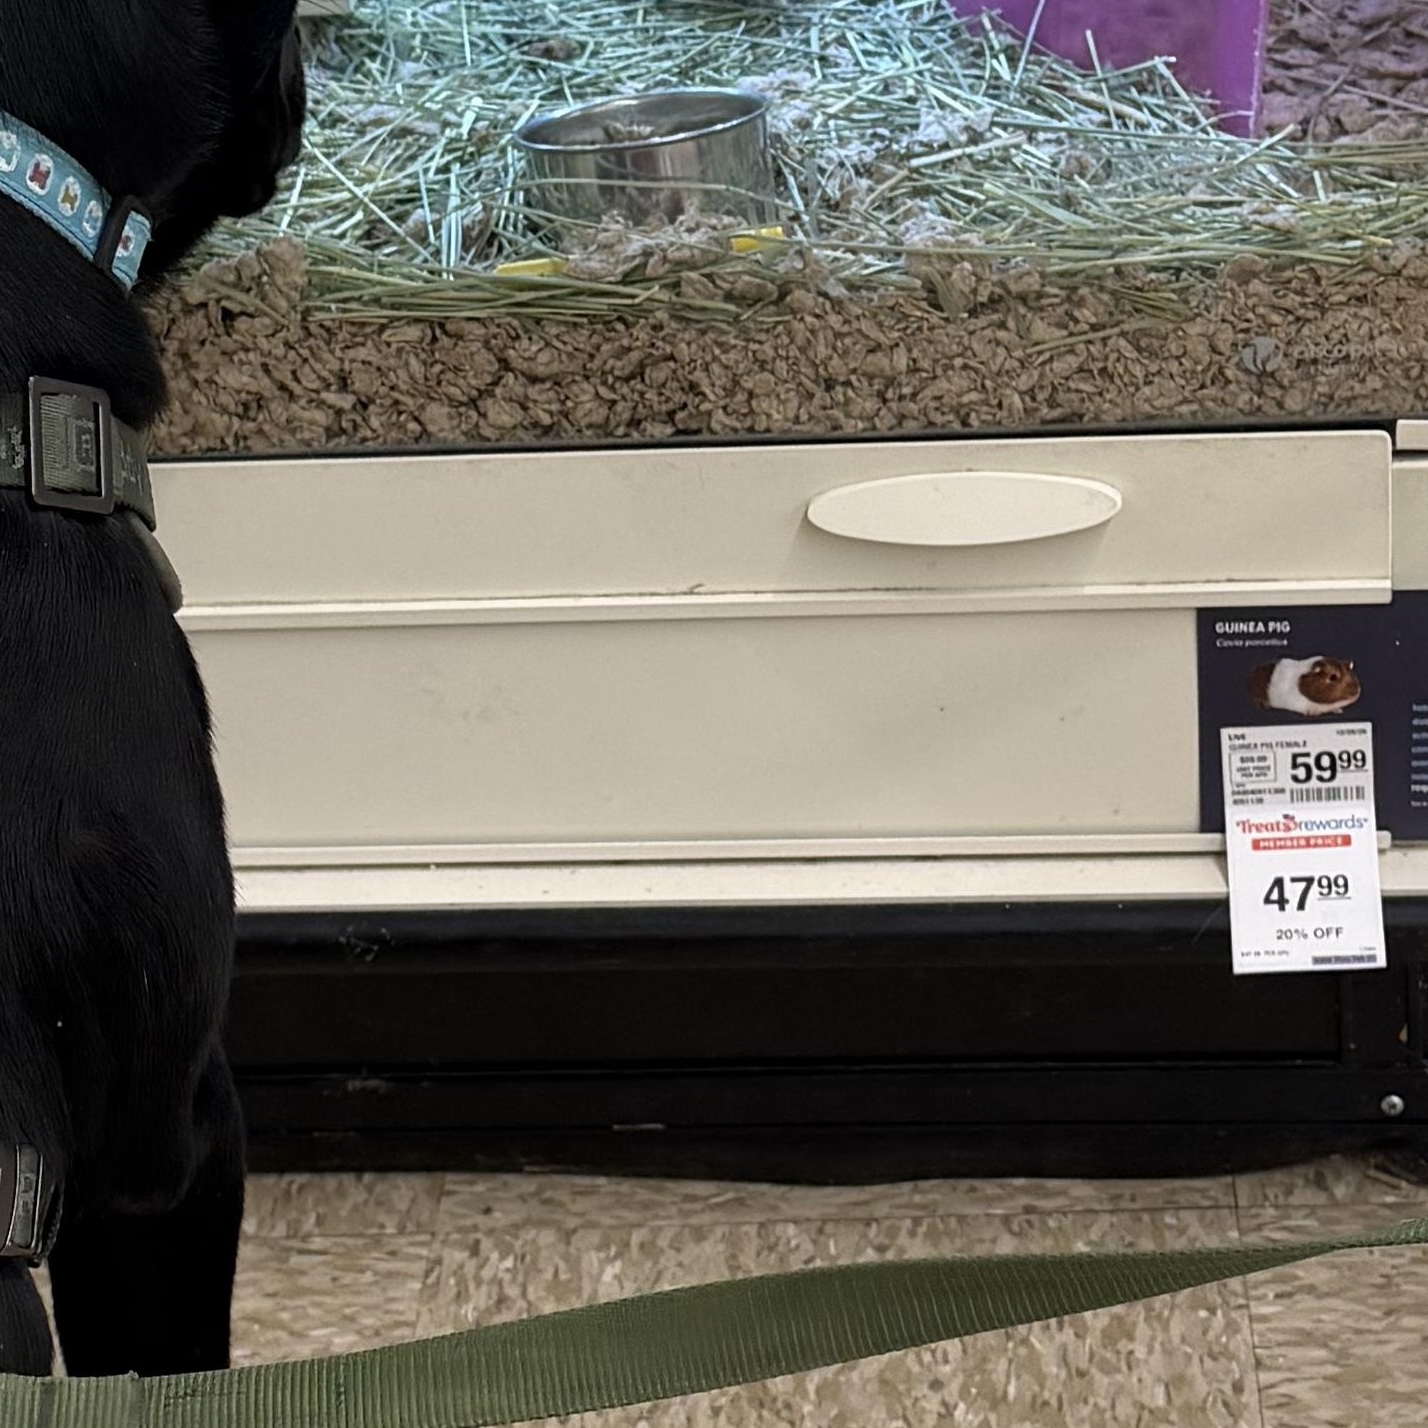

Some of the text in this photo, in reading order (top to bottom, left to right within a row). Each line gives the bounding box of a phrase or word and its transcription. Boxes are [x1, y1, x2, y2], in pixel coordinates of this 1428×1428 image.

[1215, 621, 1290, 633] GUINEA PIG
[1298, 814, 1364, 831] rewards
[1310, 836, 1343, 846] PRICE
[1276, 927, 1344, 940] 20% OFF
